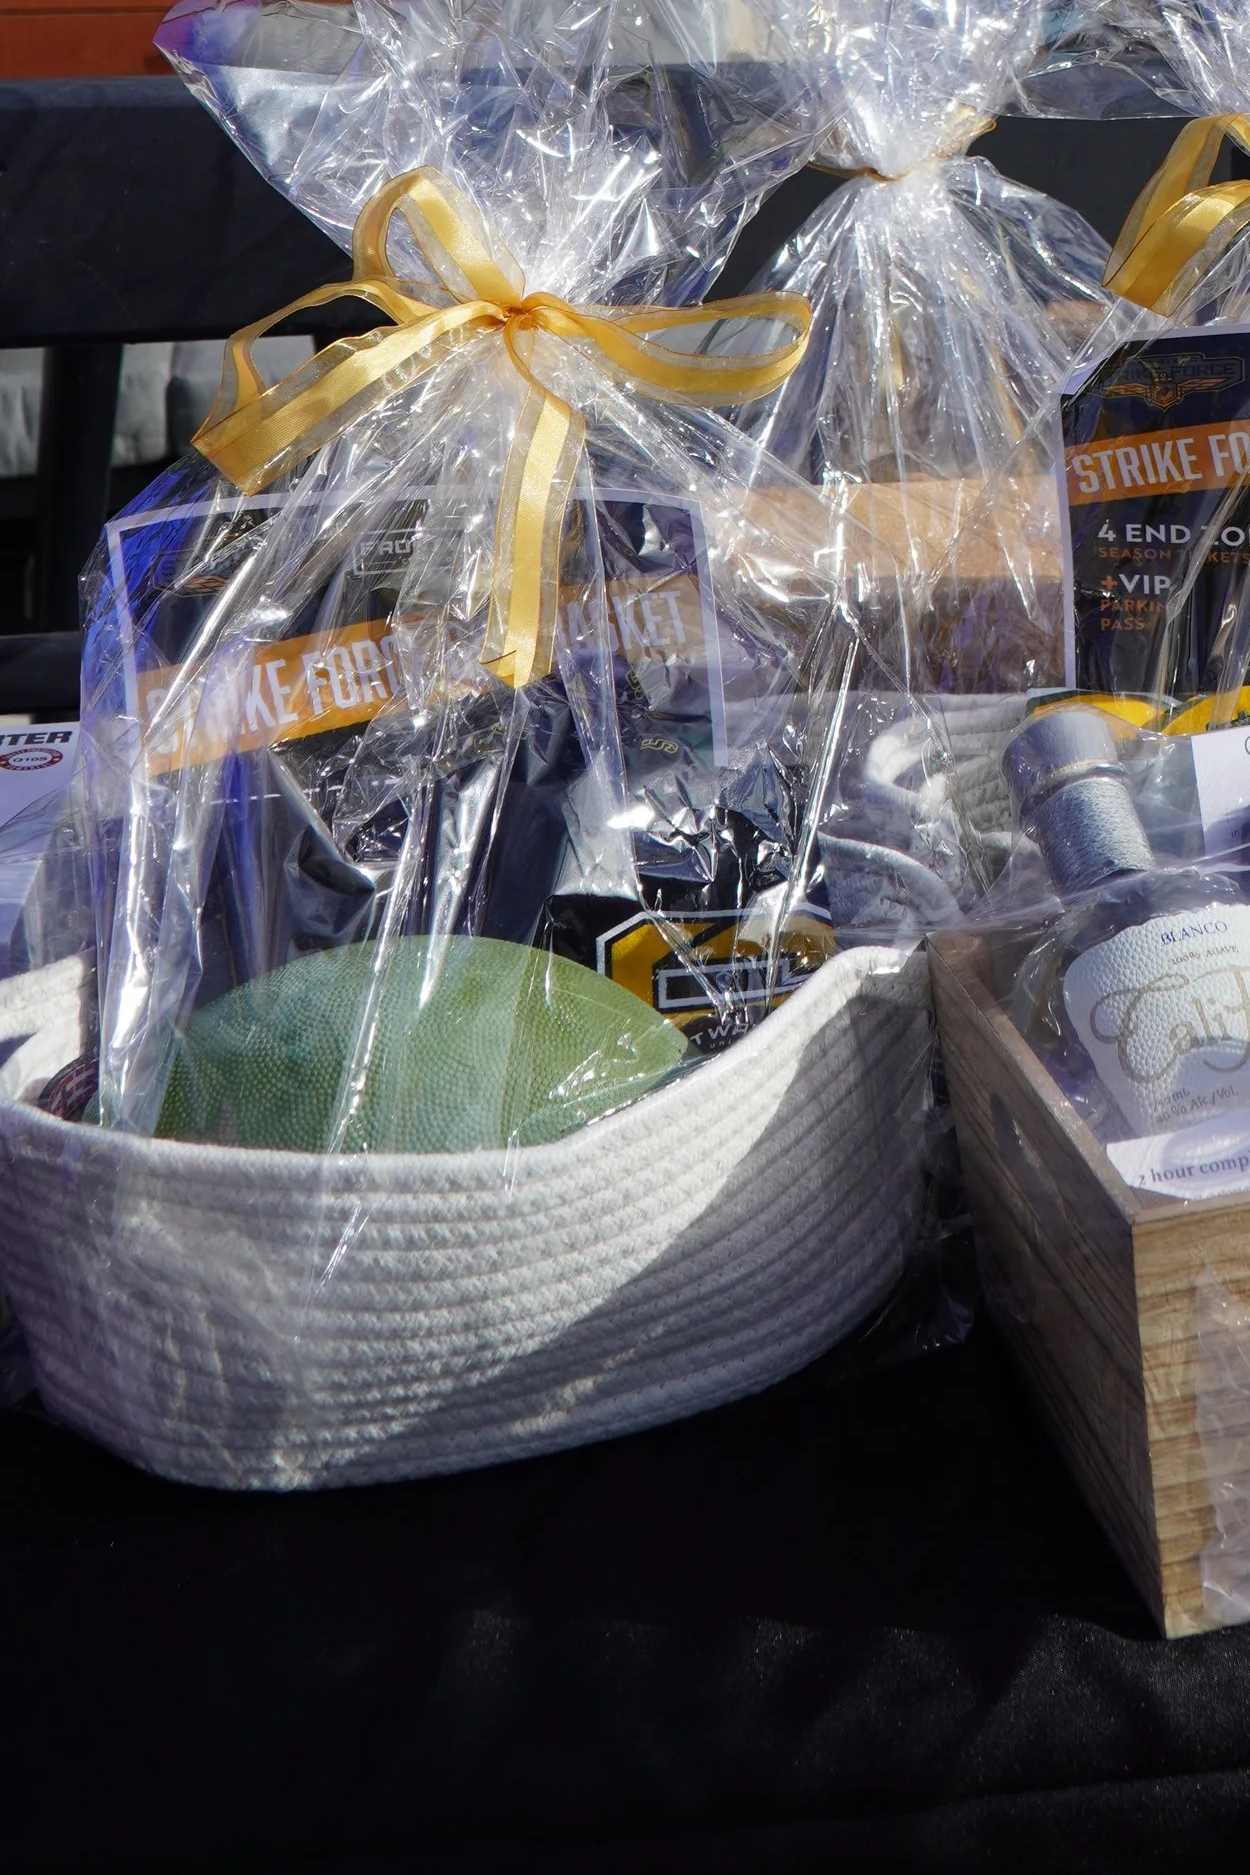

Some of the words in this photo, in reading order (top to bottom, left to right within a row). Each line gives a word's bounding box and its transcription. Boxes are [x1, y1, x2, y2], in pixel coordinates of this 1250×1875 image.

[1169, 363, 1237, 377] FORCE
[1072, 437, 1202, 493] STRIKE
[1097, 521, 1116, 542] 4
[1126, 524, 1190, 544] END
[1099, 547, 1171, 561] SEASON
[566, 590, 686, 653] ASKET
[1101, 617, 1145, 631] PASS
[0, 730, 73, 746] TER
[1161, 921, 1228, 945] BLANCO
[1206, 945, 1239, 958] AGAVE
[1138, 1175, 1147, 1187] 2
[1151, 1164, 1196, 1184] hour
